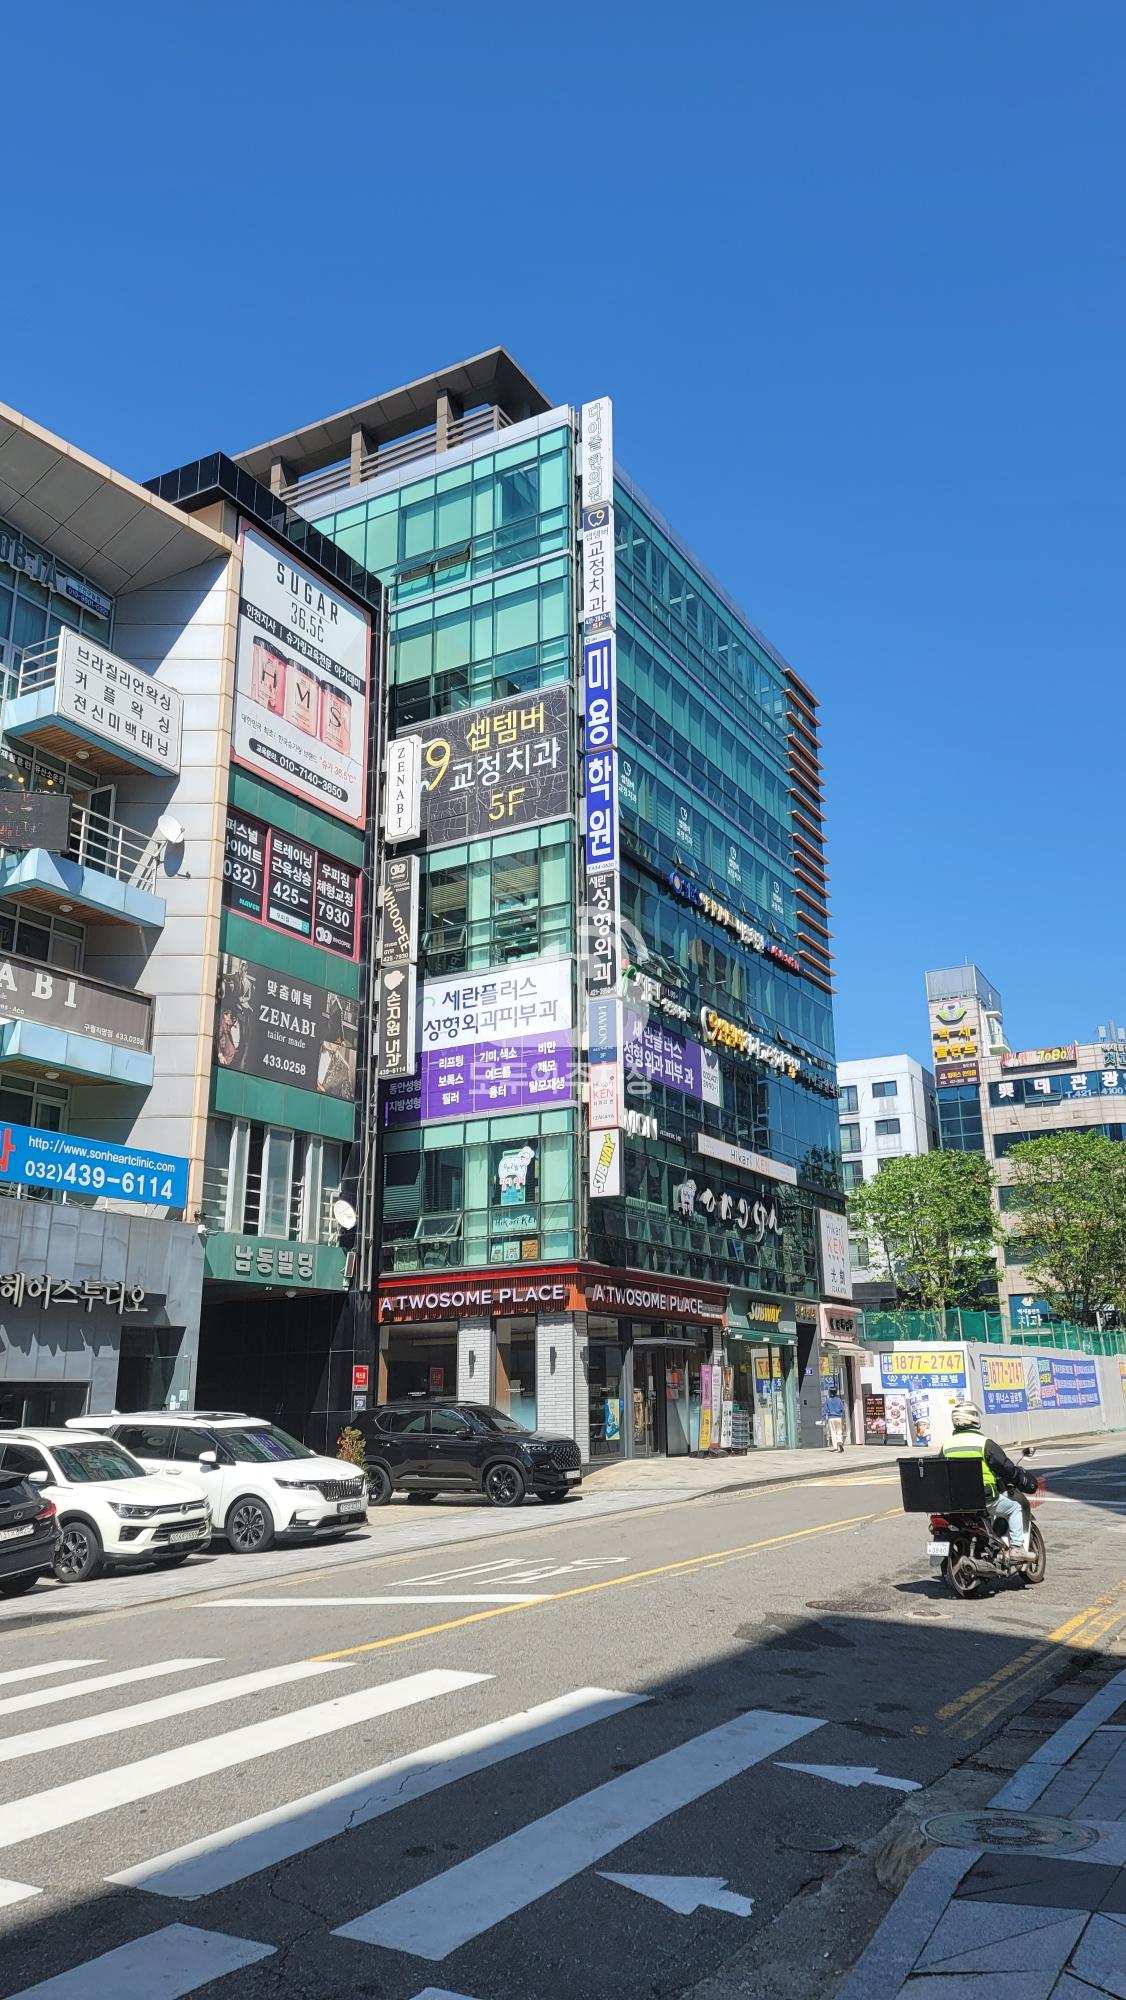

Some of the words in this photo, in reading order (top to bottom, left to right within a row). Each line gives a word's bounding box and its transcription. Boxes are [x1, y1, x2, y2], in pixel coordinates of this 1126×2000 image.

[587, 540, 607, 612] 교정치과
[277, 561, 338, 625] SUGAR
[246, 604, 277, 633] 인천지사
[334, 663, 360, 691] 아카데미
[77, 646, 171, 711] 브라질리언왁싱
[74, 694, 169, 757] 전신미백태닝
[466, 702, 544, 751] 셉템버
[449, 737, 561, 791] 교정치과
[588, 646, 611, 857] 미용학원
[279, 757, 343, 798] 010-7140-3650
[397, 747, 406, 829] ZENABI
[488, 787, 525, 820] 5F
[272, 838, 313, 869] 트레이닝
[271, 856, 313, 887] 근육상승
[322, 863, 350, 889] 우피짐
[239, 897, 260, 912] NAVER
[272, 881, 309, 906] 425-
[316, 879, 354, 908] 체형교정
[317, 901, 350, 928] 7930
[383, 886, 411, 953] WHOOPEE
[592, 887, 612, 985] 성형외과
[441, 977, 538, 1011] 세란플러스
[259, 1004, 316, 1038] ZENABI
[386, 991, 401, 1037] 손지원
[424, 1000, 558, 1041] 성형외과피부과
[267, 1030, 286, 1044] tailor
[288, 1035, 306, 1050] made
[385, 1039, 401, 1068] 내과
[438, 1054, 464, 1070] 리프팅
[538, 1040, 556, 1054] 비만
[263, 1054, 306, 1077] 433.0258
[438, 1075, 464, 1088] 보톡스
[485, 1065, 511, 1081] 여드름
[538, 1060, 557, 1073] 제모
[442, 1091, 460, 1104] 필러
[489, 1083, 506, 1098] 흉터
[529, 1076, 566, 1093] 탈모재생
[593, 1089, 614, 1099] KEN
[28, 1136, 176, 1174] http://www.sonheartclinic.com
[592, 1133, 616, 1193] SUBWAY
[235, 1244, 313, 1278] 남동빌딩
[0, 1272, 149, 1315] 헤어스투디오
[381, 1297, 393, 1311] A
[398, 1289, 492, 1310] TWOSOME
[499, 1284, 565, 1304] PLACE
[592, 1284, 605, 1302] A
[605, 1287, 666, 1310] TWOSOME
[669, 1295, 704, 1314] PLACE
[749, 1302, 782, 1323] SUBWAY
[895, 1354, 961, 1370] 1877-2747
[989, 1360, 1023, 1385] 1877-2747
